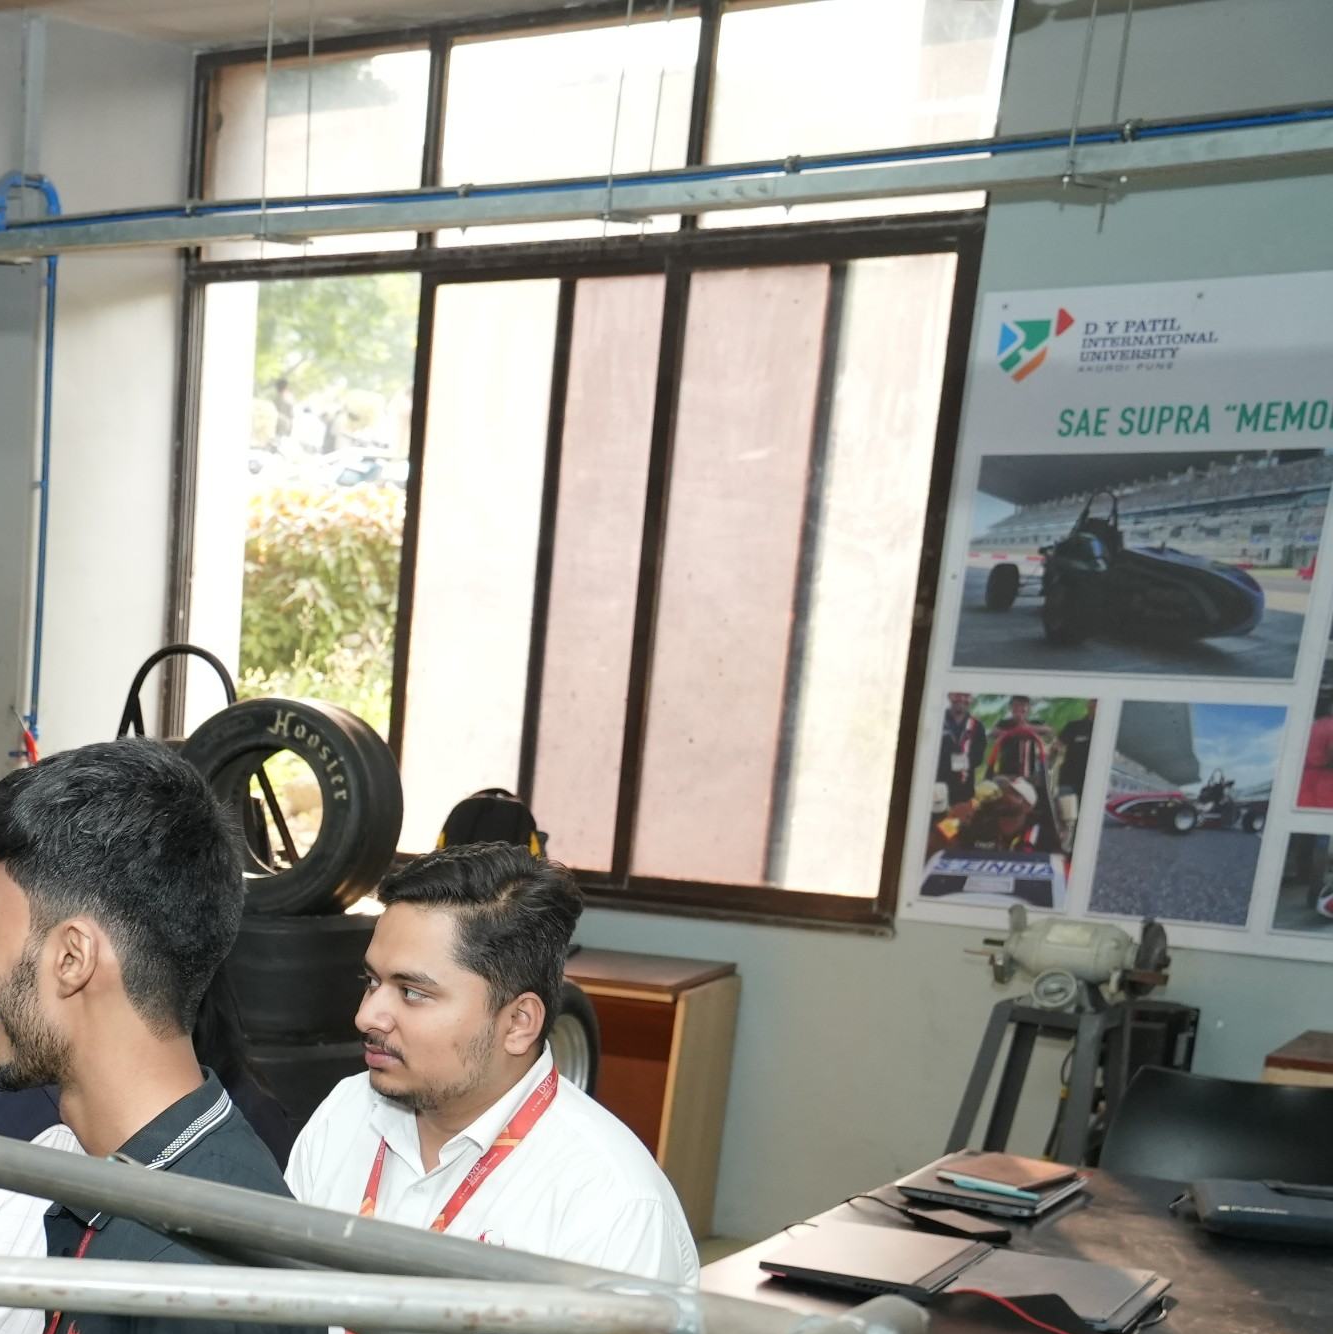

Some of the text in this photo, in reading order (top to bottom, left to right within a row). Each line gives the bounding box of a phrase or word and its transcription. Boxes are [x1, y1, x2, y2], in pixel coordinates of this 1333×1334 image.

[1085, 318, 1181, 335] D Y PATIL
[1081, 331, 1219, 349] INTERNATIONAL
[1080, 347, 1179, 362] UNIVERSITY
[1057, 399, 1333, 438] SAE SUPRA “MEMO
[267, 709, 348, 801] Hoosier
[465, 1161, 482, 1183] DYP
